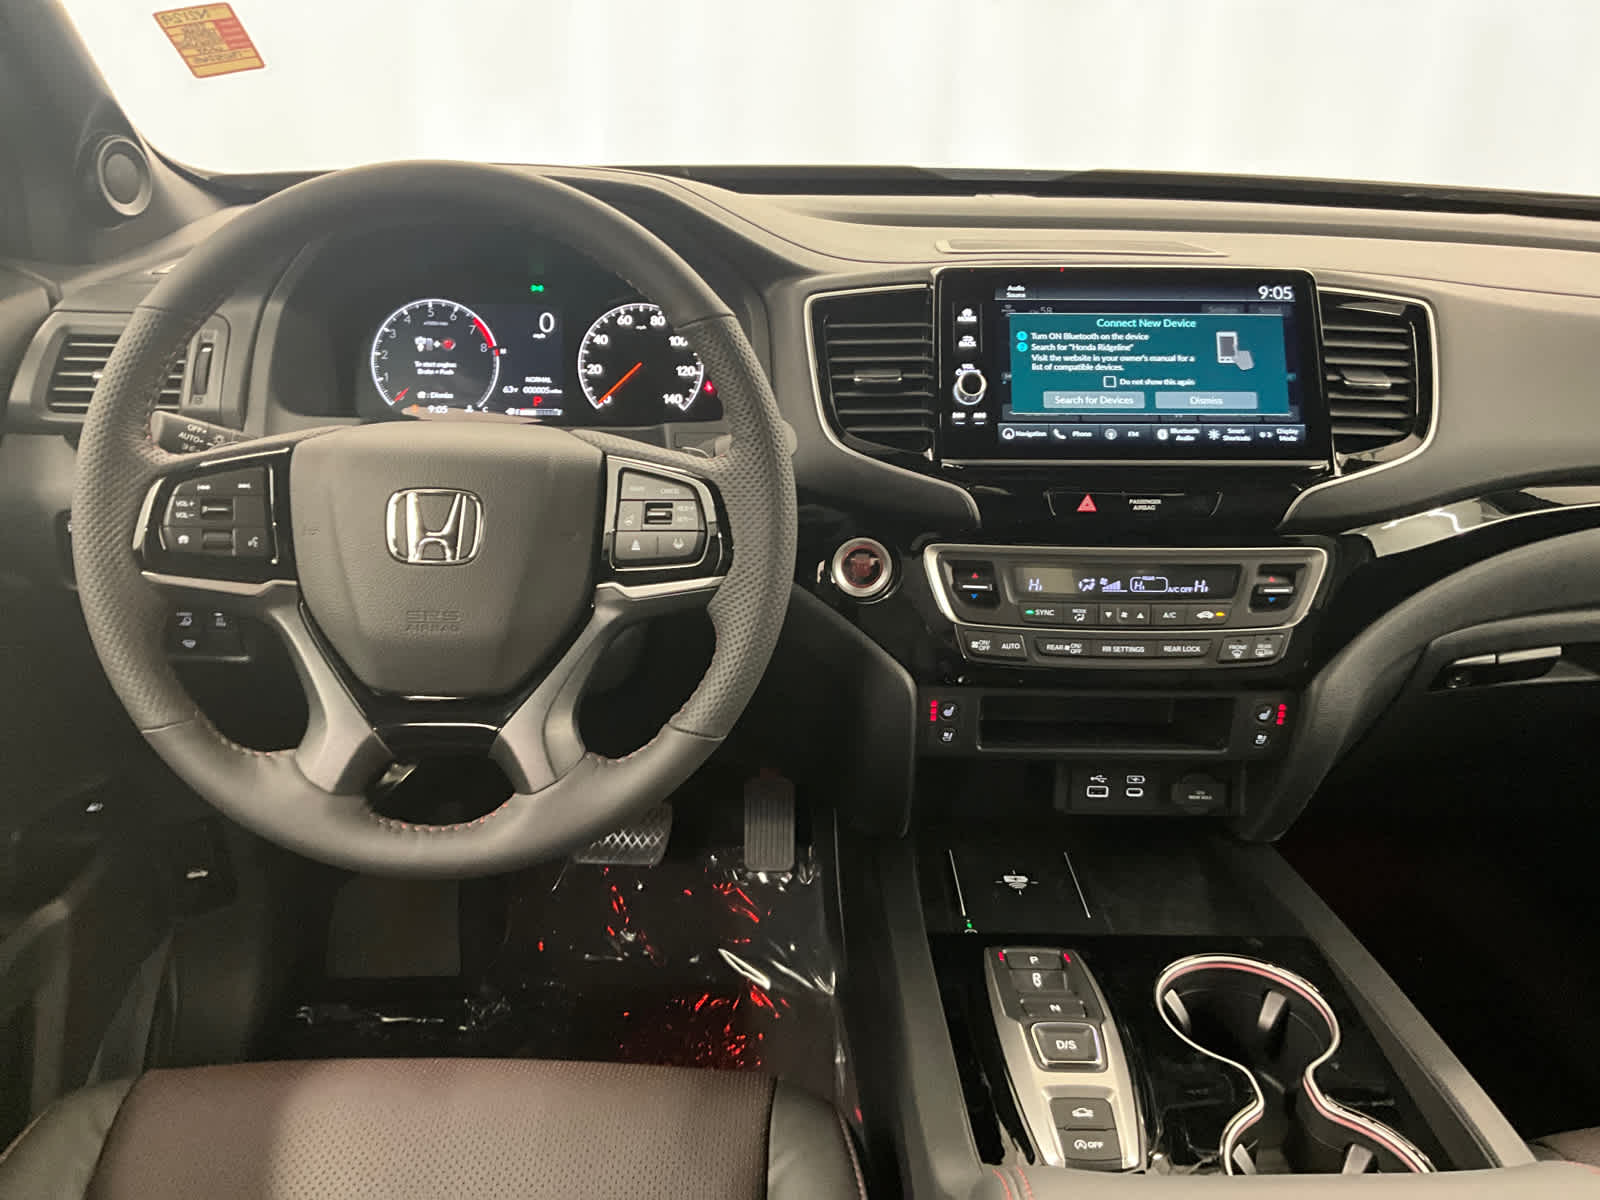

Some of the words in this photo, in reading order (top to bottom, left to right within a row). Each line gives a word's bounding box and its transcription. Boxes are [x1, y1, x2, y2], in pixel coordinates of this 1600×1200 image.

[1258, 285, 1293, 300] 9:05
[428, 309, 435, 317] 5
[450, 313, 457, 321] 6
[404, 315, 411, 324] 4
[539, 312, 555, 333] 0
[617, 315, 633, 326] 60
[650, 315, 666, 326] 80
[1096, 318, 1137, 328] Connect
[1139, 318, 1162, 328] New
[1163, 319, 1197, 328] Device
[389, 329, 397, 338] 3
[469, 325, 477, 334] 7
[593, 335, 609, 345] 40
[1031, 332, 1048, 341] Turn
[1049, 332, 1062, 341] ON
[1063, 332, 1099, 341] Bluetooth
[1111, 332, 1124, 341] the
[1125, 332, 1149, 341] device
[480, 343, 488, 352] 8
[1031, 343, 1056, 352] Search
[1057, 343, 1068, 352] for
[1068, 343, 1096, 352] "Honda
[1097, 343, 1134, 353] Ridgeline"
[381, 351, 389, 360] 2
[1031, 354, 1048, 362] Visit
[1049, 354, 1062, 362] the
[1063, 354, 1092, 362] website
[1093, 354, 1100, 362] in
[1101, 355, 1119, 363] your
[1119, 354, 1148, 362] owner's
[1177, 354, 1189, 362] for
[588, 364, 602, 375] 20
[676, 365, 695, 376] 120
[1031, 362, 1043, 371] list
[1044, 362, 1053, 371] of
[1053, 362, 1094, 372] compatible
[1094, 362, 1125, 371] devices.
[1119, 378, 1130, 386] Do
[1132, 378, 1144, 386] not
[1145, 378, 1162, 386] show
[1163, 378, 1175, 386] this
[1176, 378, 1195, 387] again
[533, 396, 543, 407] P
[663, 394, 683, 405] 140
[1055, 395, 1083, 405] Search
[1085, 395, 1098, 405] for
[1100, 395, 1134, 405] Devices
[1189, 396, 1224, 405] Dismiss
[427, 404, 449, 413] 9:05
[187, 423, 203, 434] OFF
[178, 431, 200, 444] AUTO
[1015, 430, 1047, 438] Navigation
[1072, 430, 1093, 438] Phone
[1162, 611, 1177, 619] A/C
[1001, 642, 1021, 650] AUTO
[1046, 643, 1064, 651] REAR
[1113, 645, 1145, 653] SETTINGS
[1163, 645, 1182, 653] REAR
[1183, 645, 1201, 653] LOCK
[1029, 956, 1039, 964] P
[1049, 1004, 1062, 1012] N
[1055, 1039, 1078, 1050] D/S
[1086, 1140, 1104, 1149] OFF
